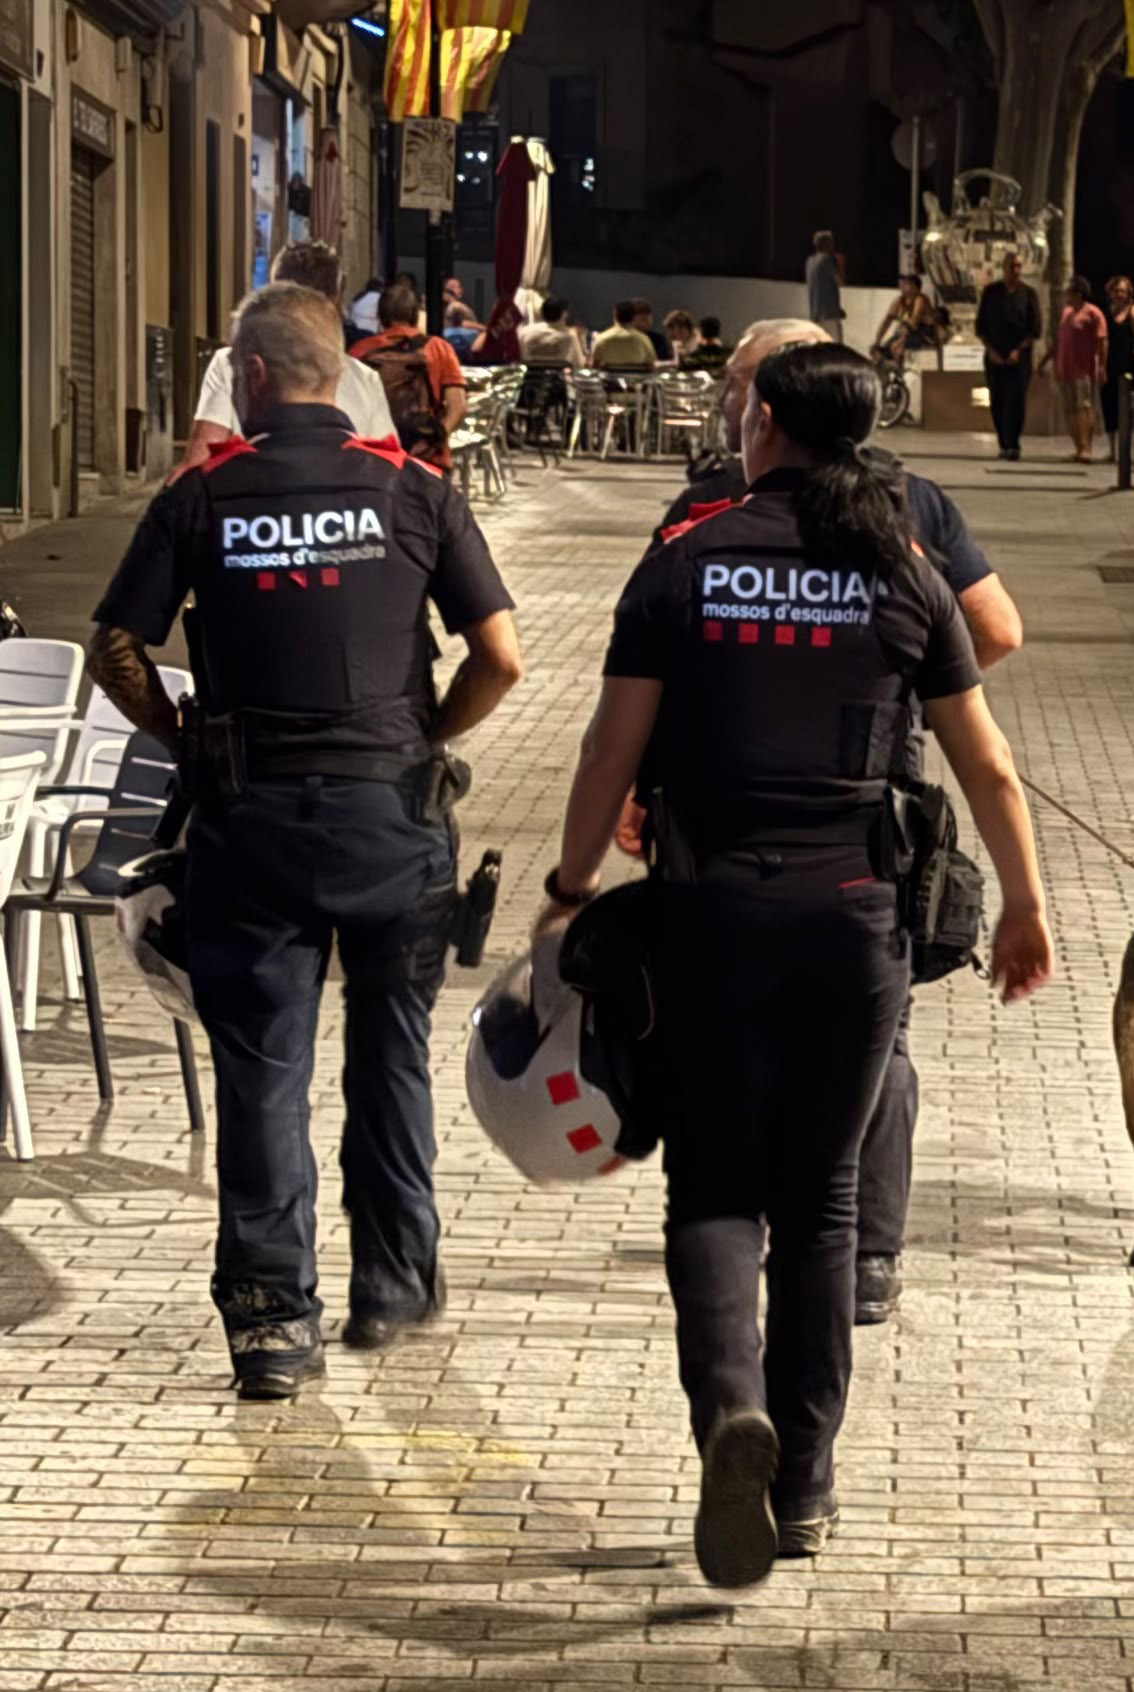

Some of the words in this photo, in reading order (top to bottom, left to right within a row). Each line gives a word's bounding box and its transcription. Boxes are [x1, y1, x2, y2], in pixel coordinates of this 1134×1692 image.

[223, 508, 385, 549] POLICIA
[224, 553, 291, 568] mossos
[292, 544, 386, 565] d'esquadra
[703, 564, 871, 603] POLICIA
[703, 603, 770, 620] mossos
[774, 603, 870, 625] d'esquadra
